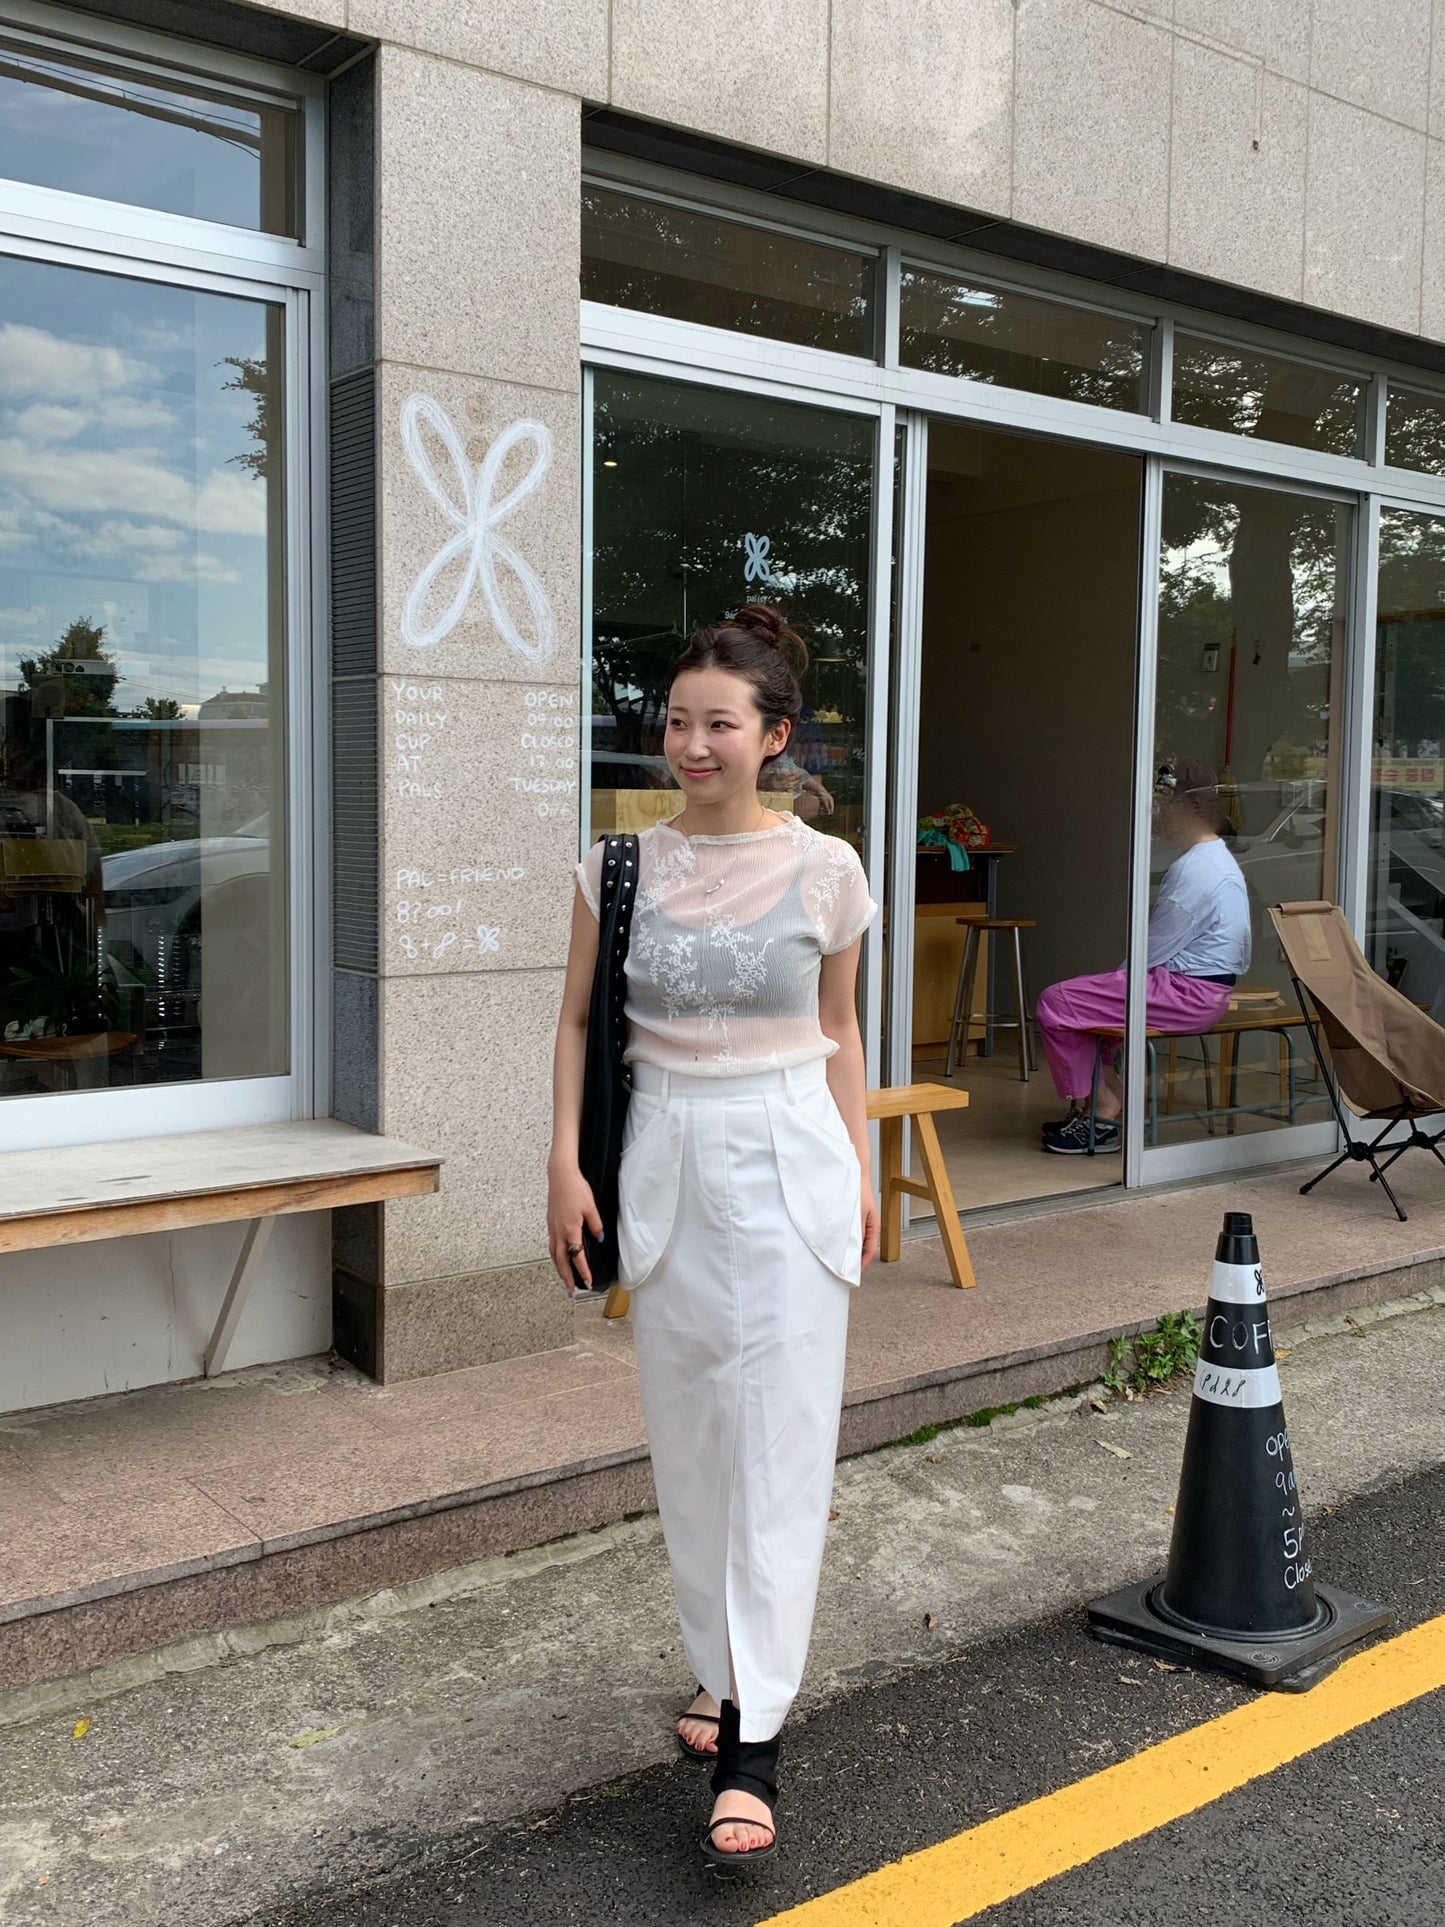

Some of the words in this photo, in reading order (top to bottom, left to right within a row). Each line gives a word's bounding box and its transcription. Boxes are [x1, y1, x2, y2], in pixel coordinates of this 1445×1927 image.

[392, 680, 443, 700] YOUR
[525, 691, 573, 707] OPEN
[395, 710, 448, 728] DAILY
[396, 733, 431, 750] CUP
[521, 732, 574, 748] CLOSED
[398, 754, 421, 772] AT
[400, 779, 442, 799] PALS
[509, 777, 577, 793] TUESDAY
[537, 802, 571, 817] OFF
[397, 868, 433, 889] PAL
[450, 867, 526, 884] FRIEND
